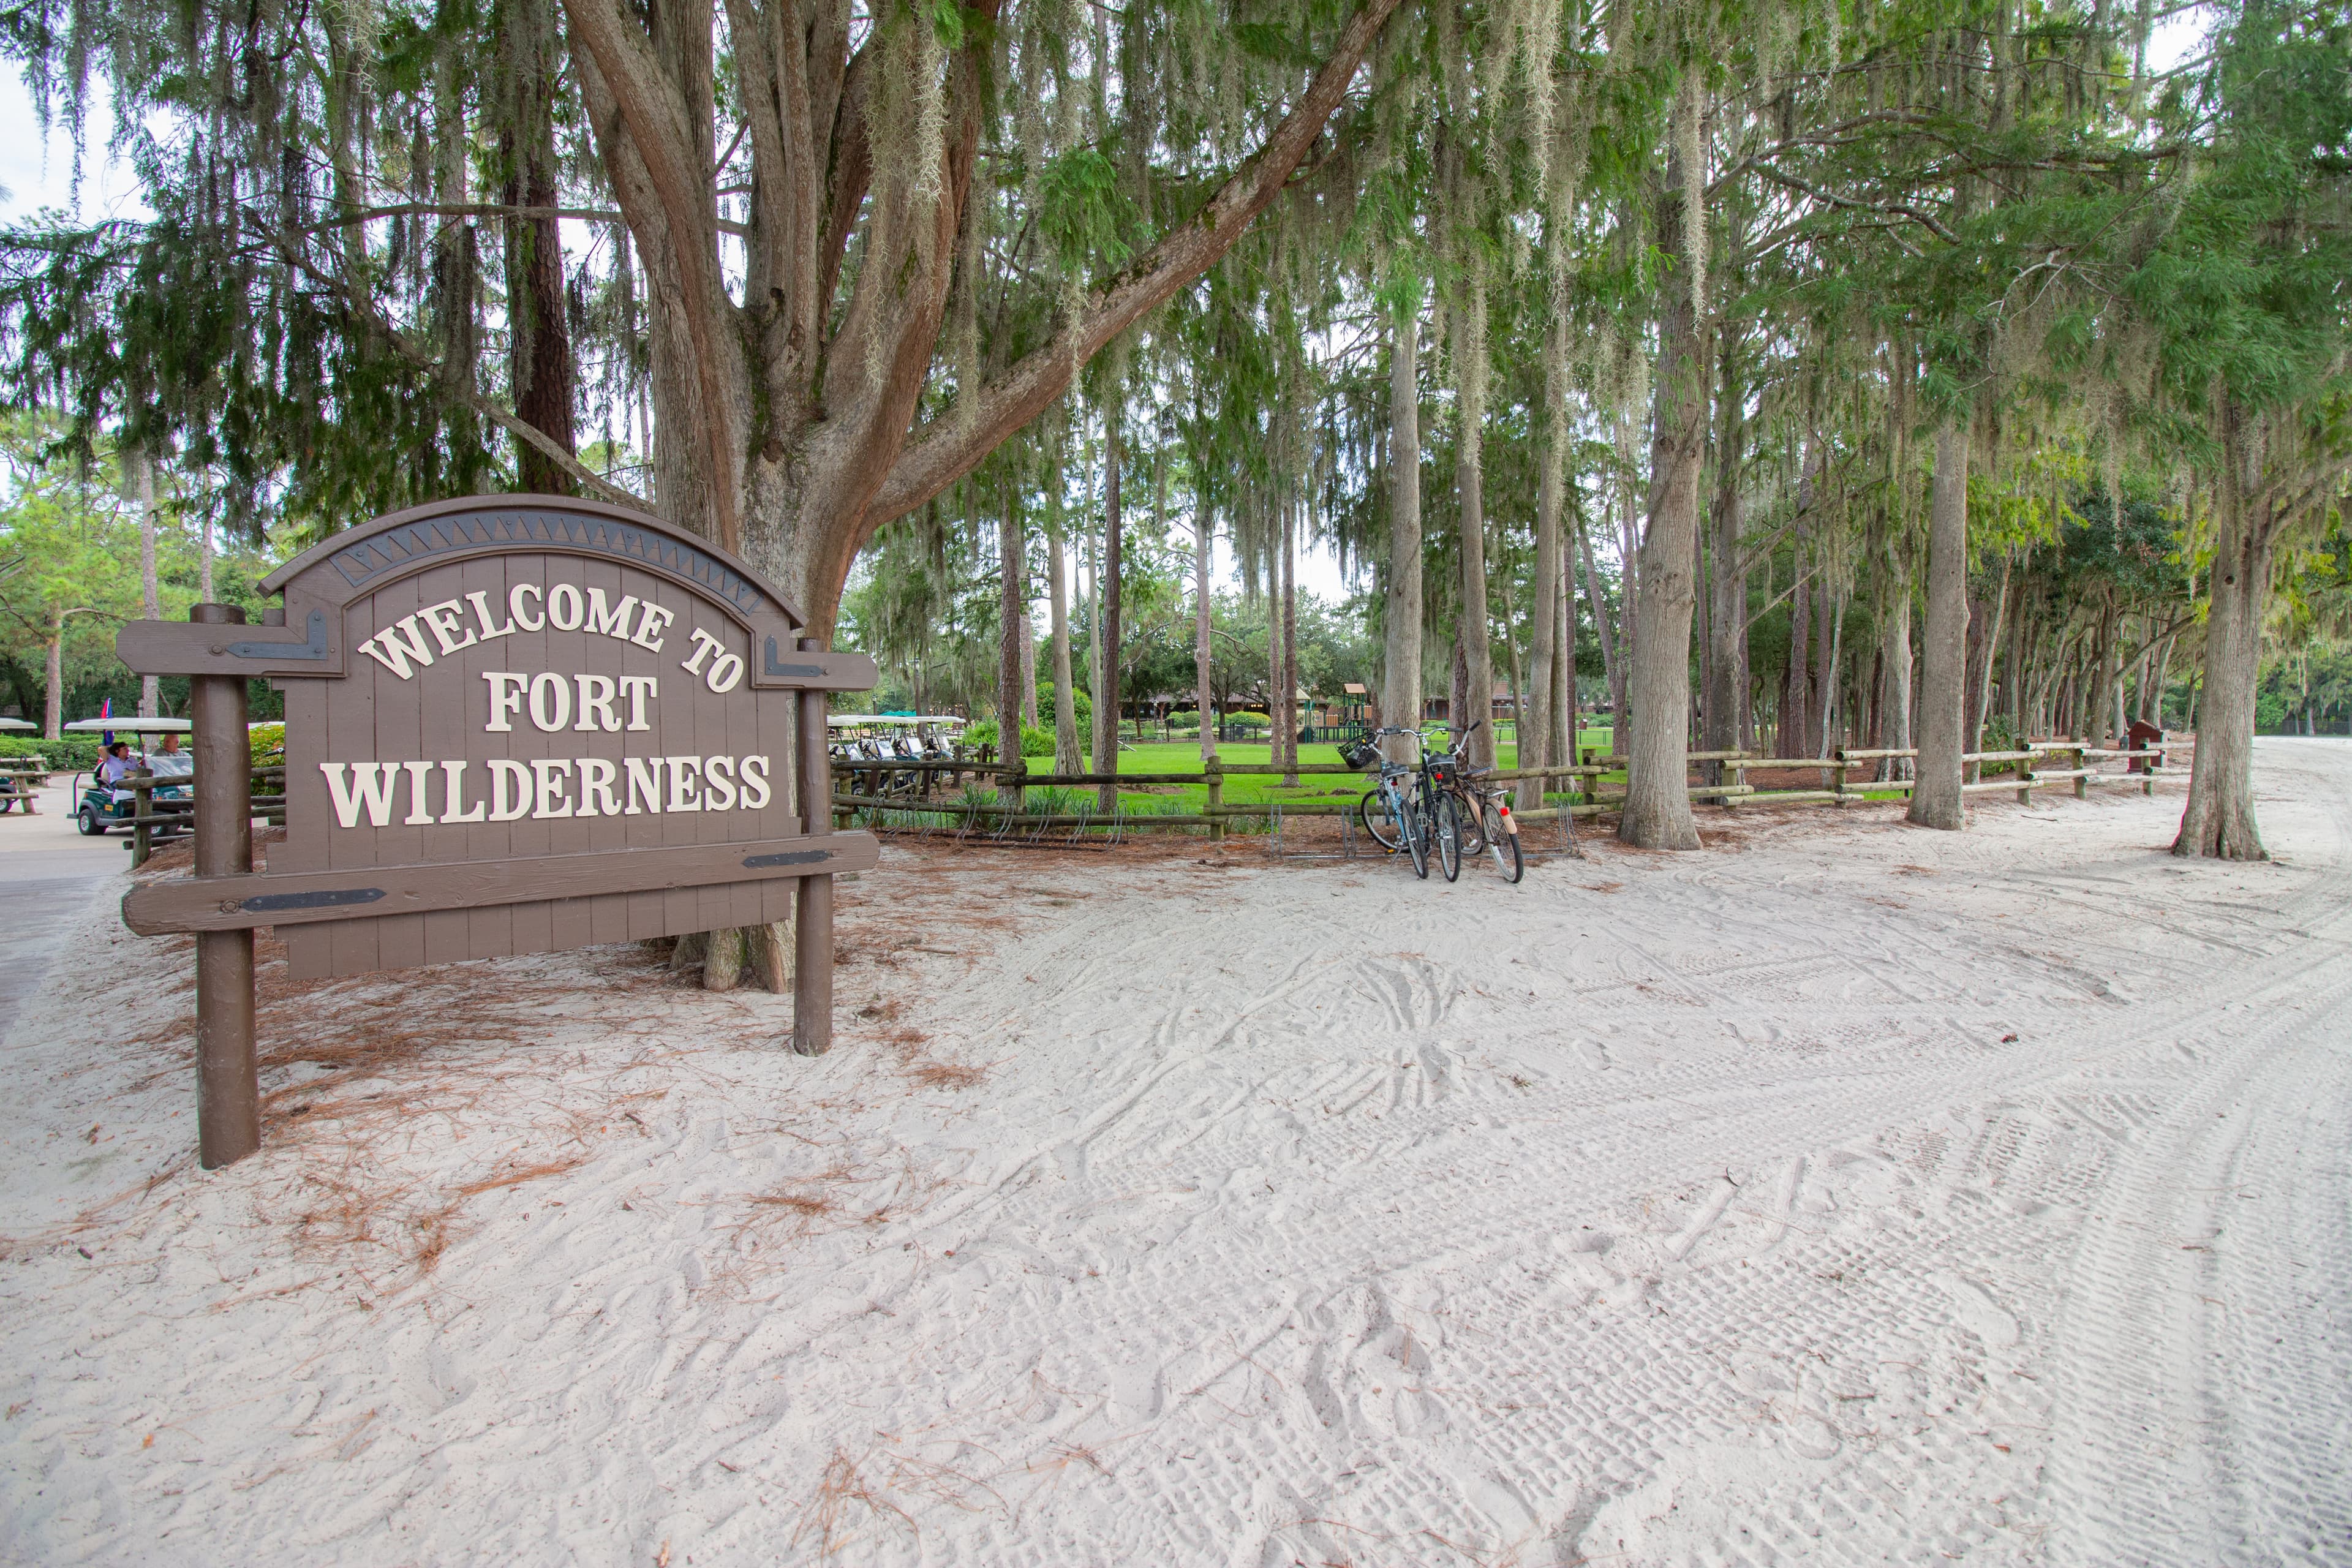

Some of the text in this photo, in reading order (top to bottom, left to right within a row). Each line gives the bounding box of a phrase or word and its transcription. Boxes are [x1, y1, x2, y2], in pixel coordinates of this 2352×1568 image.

[357, 582, 744, 693] WELCOME TO
[481, 671, 658, 733] FORT
[319, 754, 771, 828] WILDERNESS
